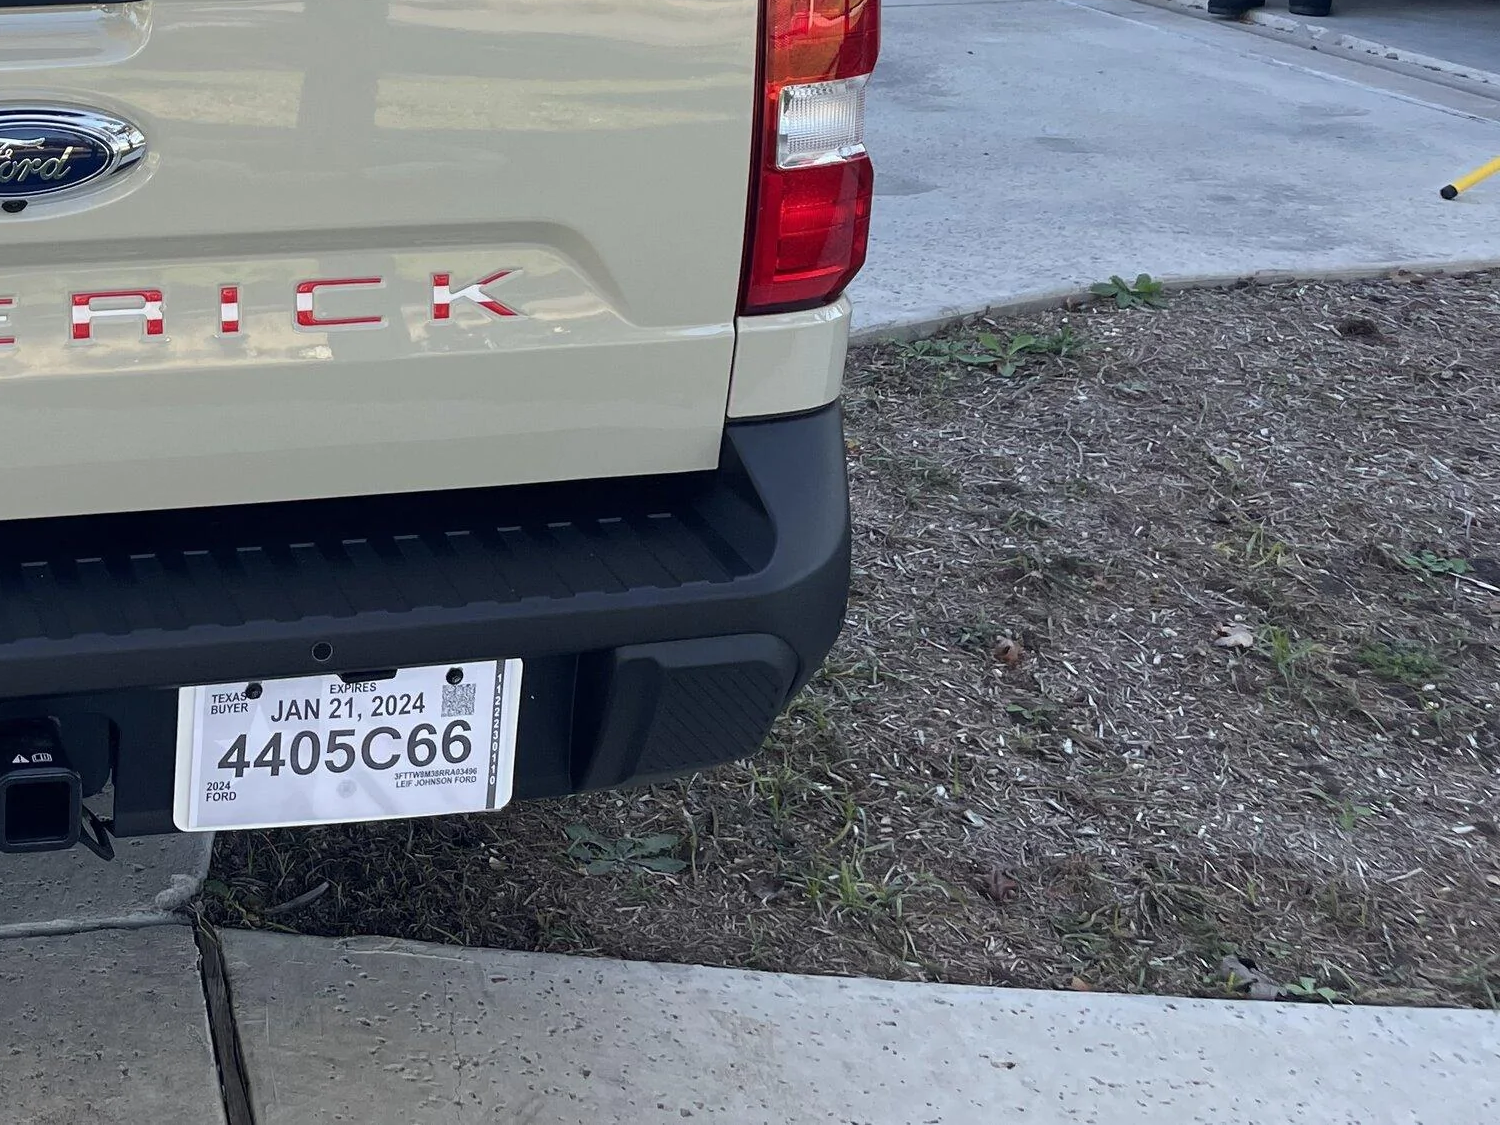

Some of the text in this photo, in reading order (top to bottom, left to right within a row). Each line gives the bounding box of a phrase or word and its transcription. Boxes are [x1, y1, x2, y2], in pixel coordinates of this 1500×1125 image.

[329, 682, 377, 694] EXPIRES
[212, 691, 248, 704] TEXAS
[211, 702, 248, 715] BUYER
[270, 692, 426, 723] JAN 21, 2024
[217, 719, 472, 778] 4405C66
[206, 781, 231, 791] 2024
[395, 775, 477, 788] LEIF JOHNSON FORD
[206, 791, 237, 802] FORD
